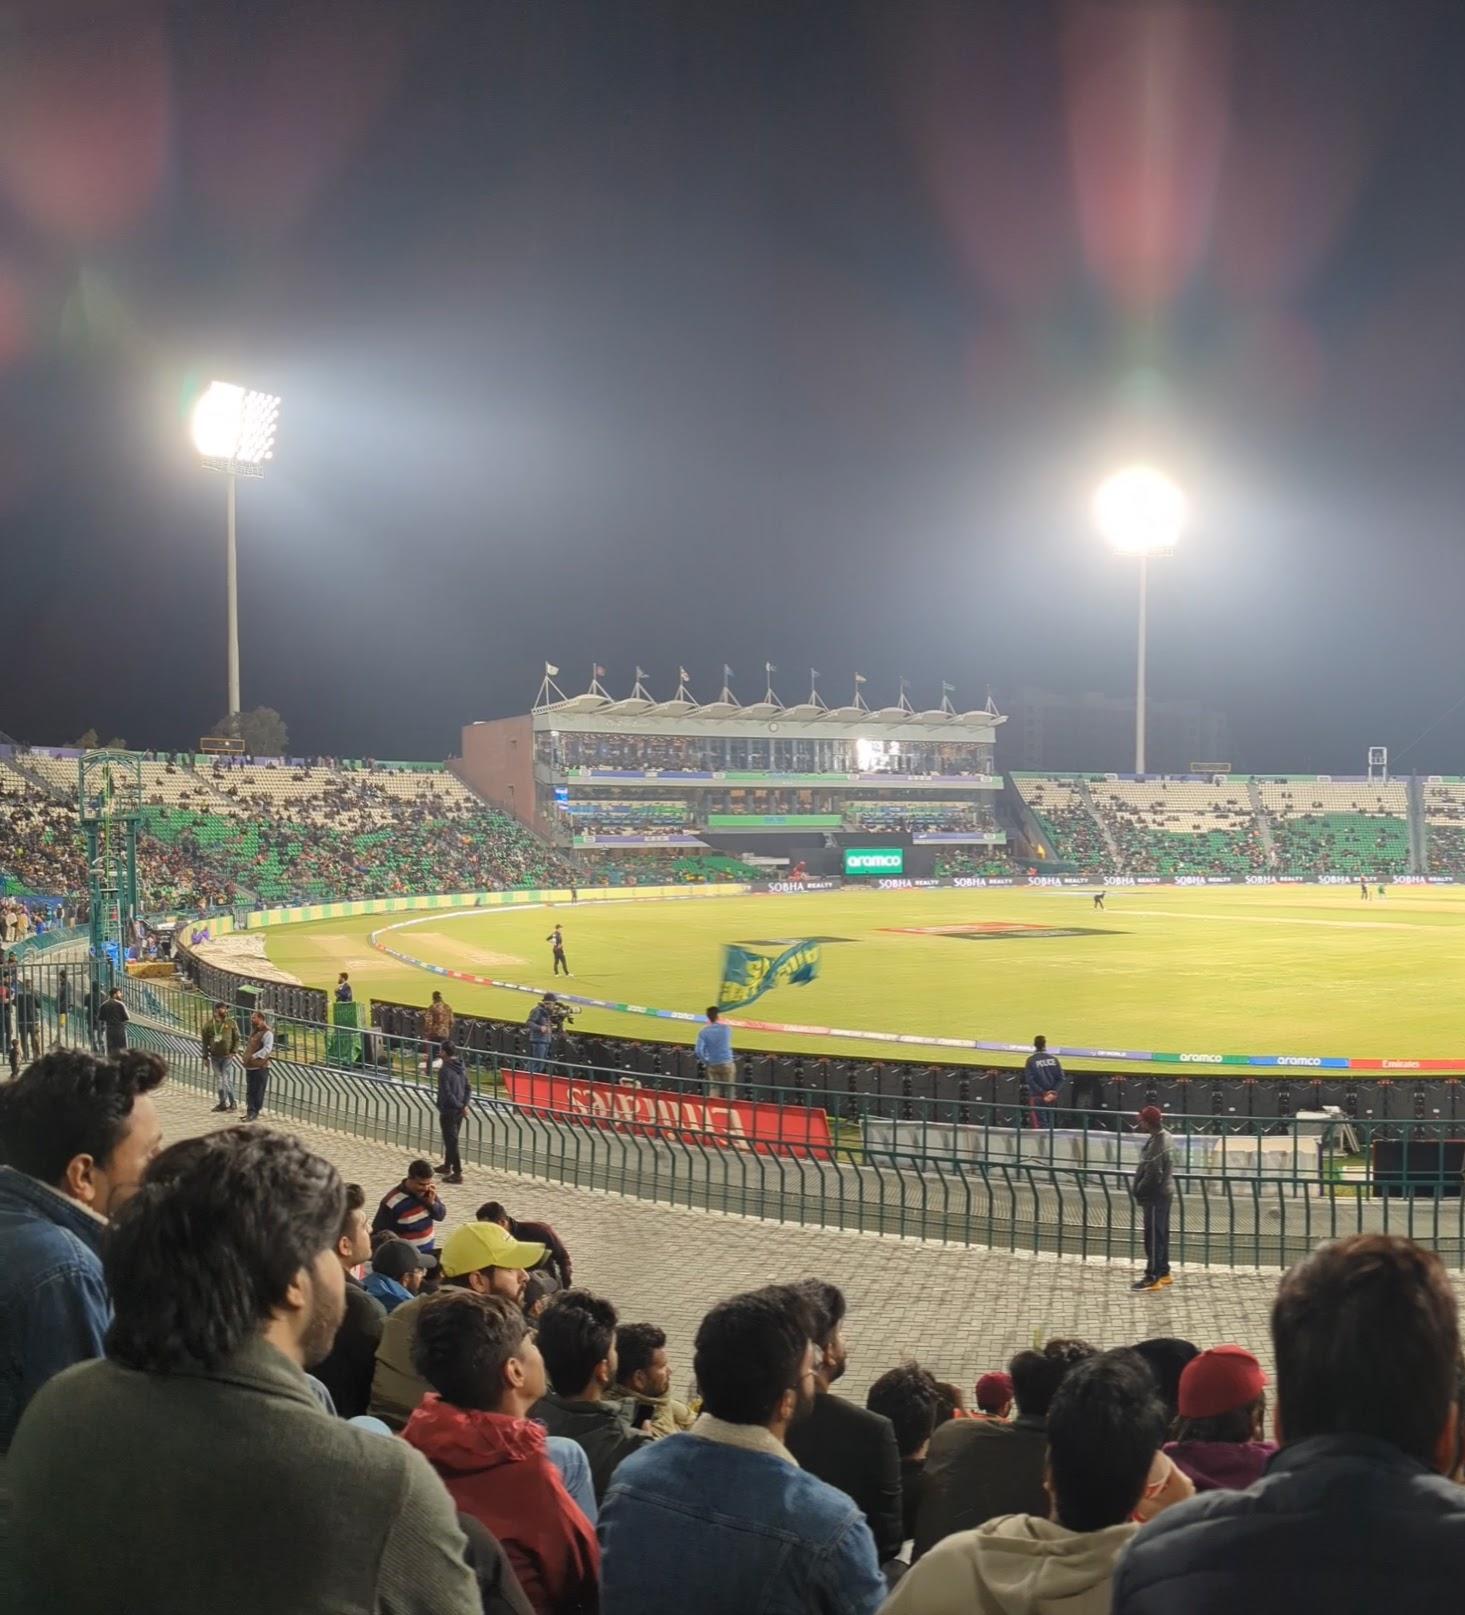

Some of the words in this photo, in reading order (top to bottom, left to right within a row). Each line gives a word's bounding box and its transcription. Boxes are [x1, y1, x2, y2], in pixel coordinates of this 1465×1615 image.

[848, 855, 900, 867] aramco
[879, 878, 912, 889] SOBHA
[954, 877, 986, 887] SOBHA
[1028, 876, 1062, 886] SOBHA
[1103, 876, 1136, 886] SOBHA
[1174, 876, 1206, 885] SOBHA
[1245, 876, 1277, 884] SOBHA
[1318, 875, 1350, 884] SOBHA
[1392, 876, 1426, 884] SOBHA
[768, 882, 804, 892] SOBHA
[1036, 1058, 1056, 1068] POLICE
[1180, 1053, 1222, 1063] aramco
[1277, 1056, 1321, 1066] aramco
